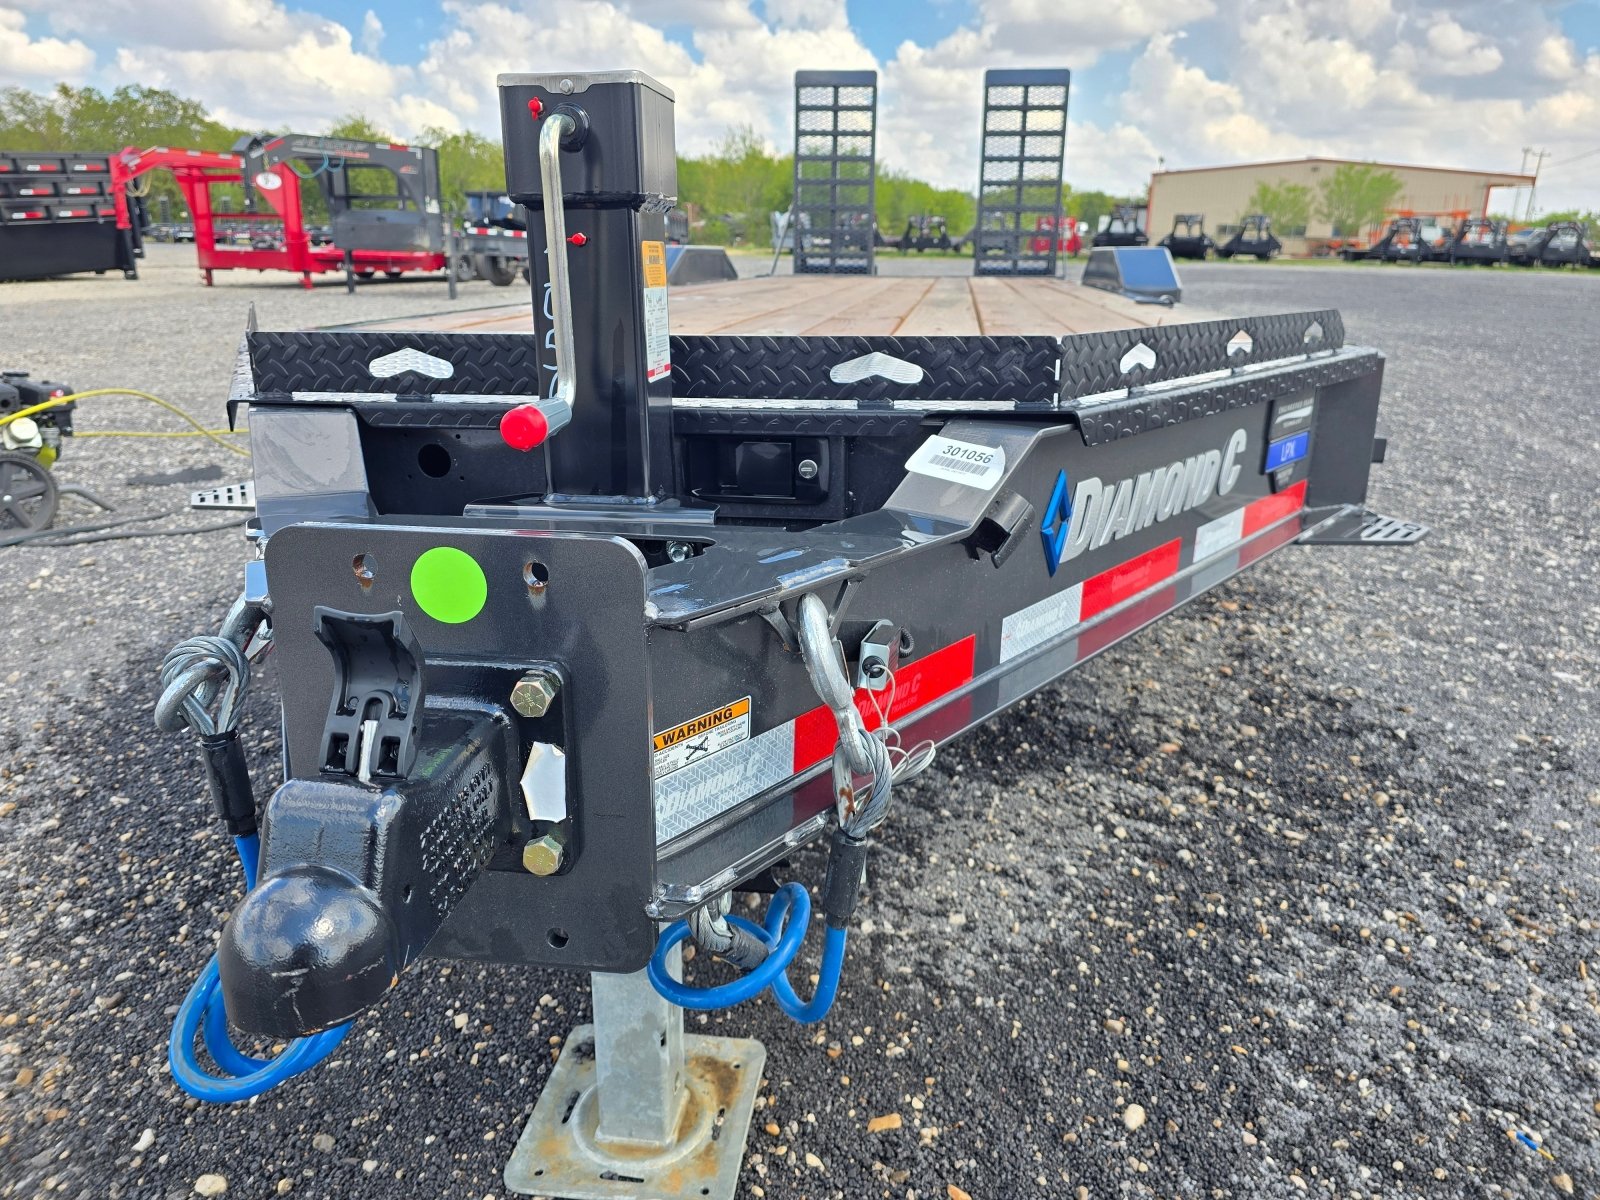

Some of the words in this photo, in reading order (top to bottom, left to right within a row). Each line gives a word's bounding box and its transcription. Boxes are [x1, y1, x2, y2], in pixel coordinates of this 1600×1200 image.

[942, 445, 994, 463] 301056
[1060, 450, 1221, 563] DIAMOND
[1219, 429, 1247, 496] C
[911, 673, 922, 691] C
[662, 708, 733, 746] WARNING
